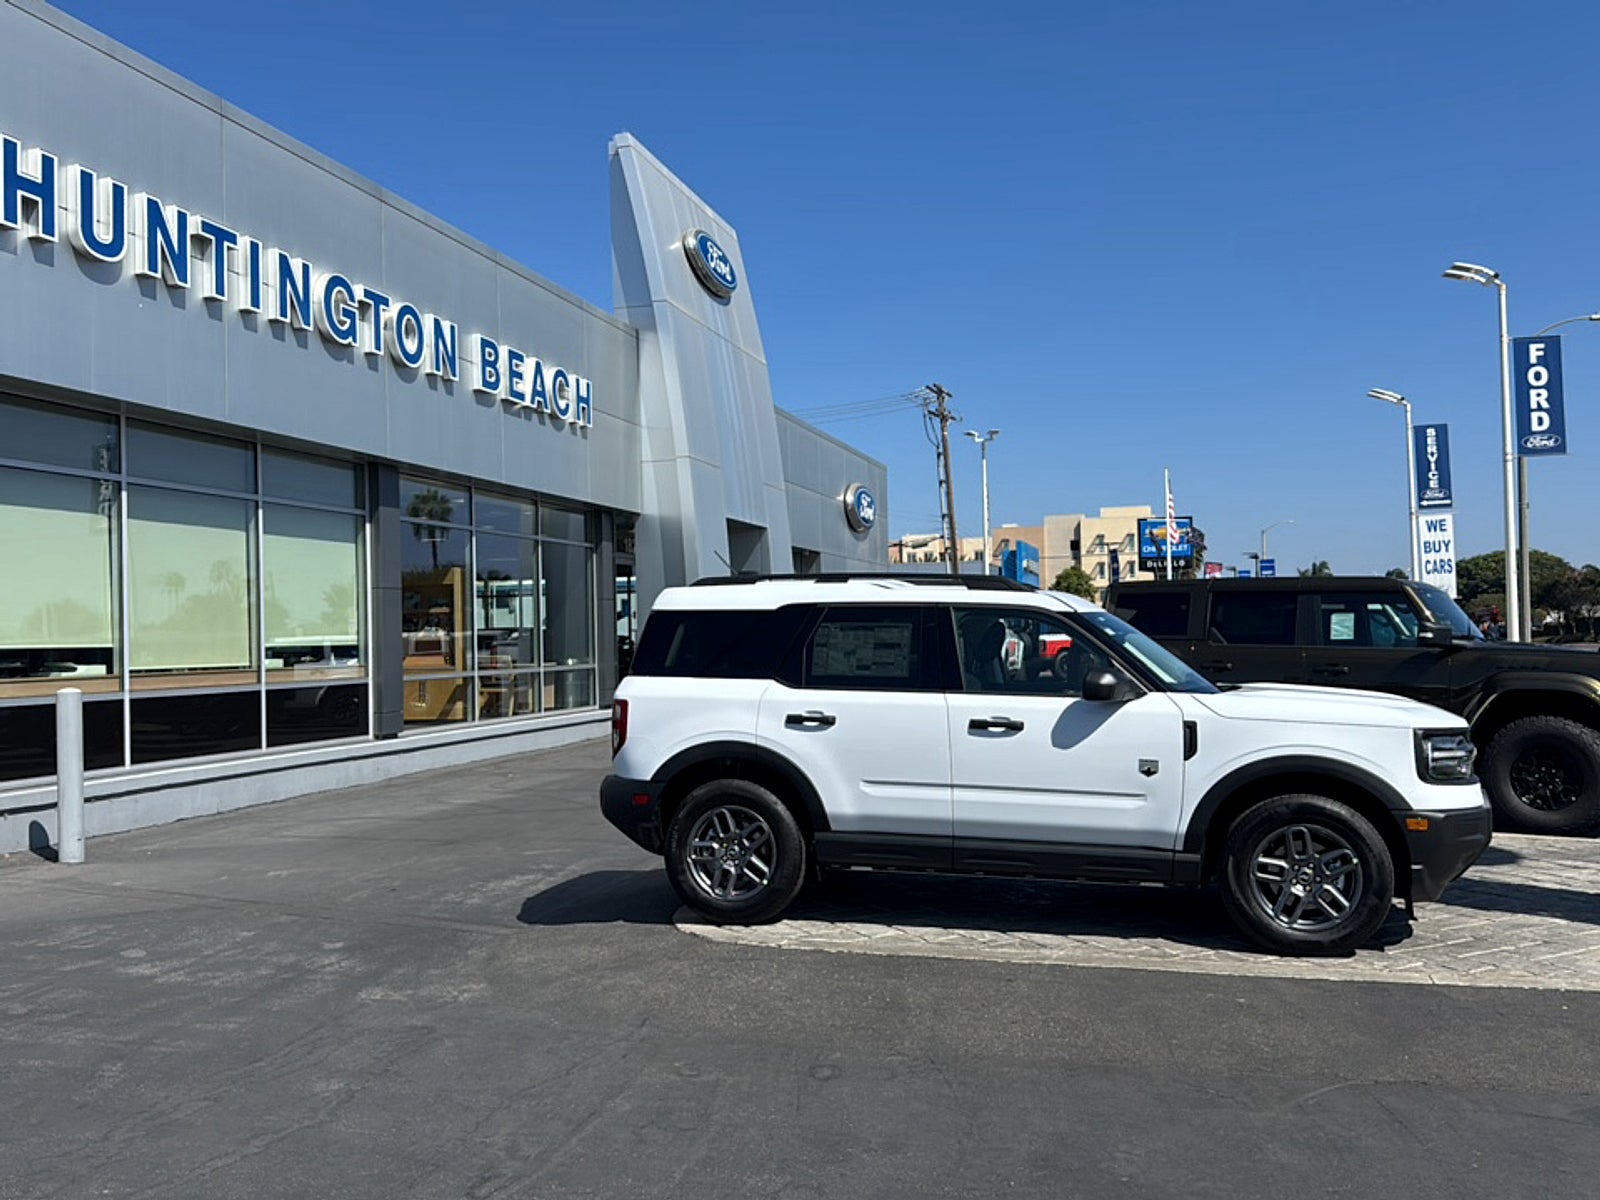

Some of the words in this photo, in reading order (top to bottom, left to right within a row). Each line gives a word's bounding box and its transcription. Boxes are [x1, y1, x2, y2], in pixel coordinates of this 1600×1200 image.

[706, 241, 732, 282] Ford
[0, 133, 459, 382] HUNTINGTON
[473, 333, 593, 428] BEACH
[1527, 343, 1550, 432] FORD
[1525, 434, 1557, 449] Ford
[1426, 428, 1440, 489] SERVICE
[860, 493, 875, 521] Ford
[1425, 519, 1448, 533] WE
[1423, 540, 1451, 554] BUY
[1425, 559, 1453, 575] CARS
